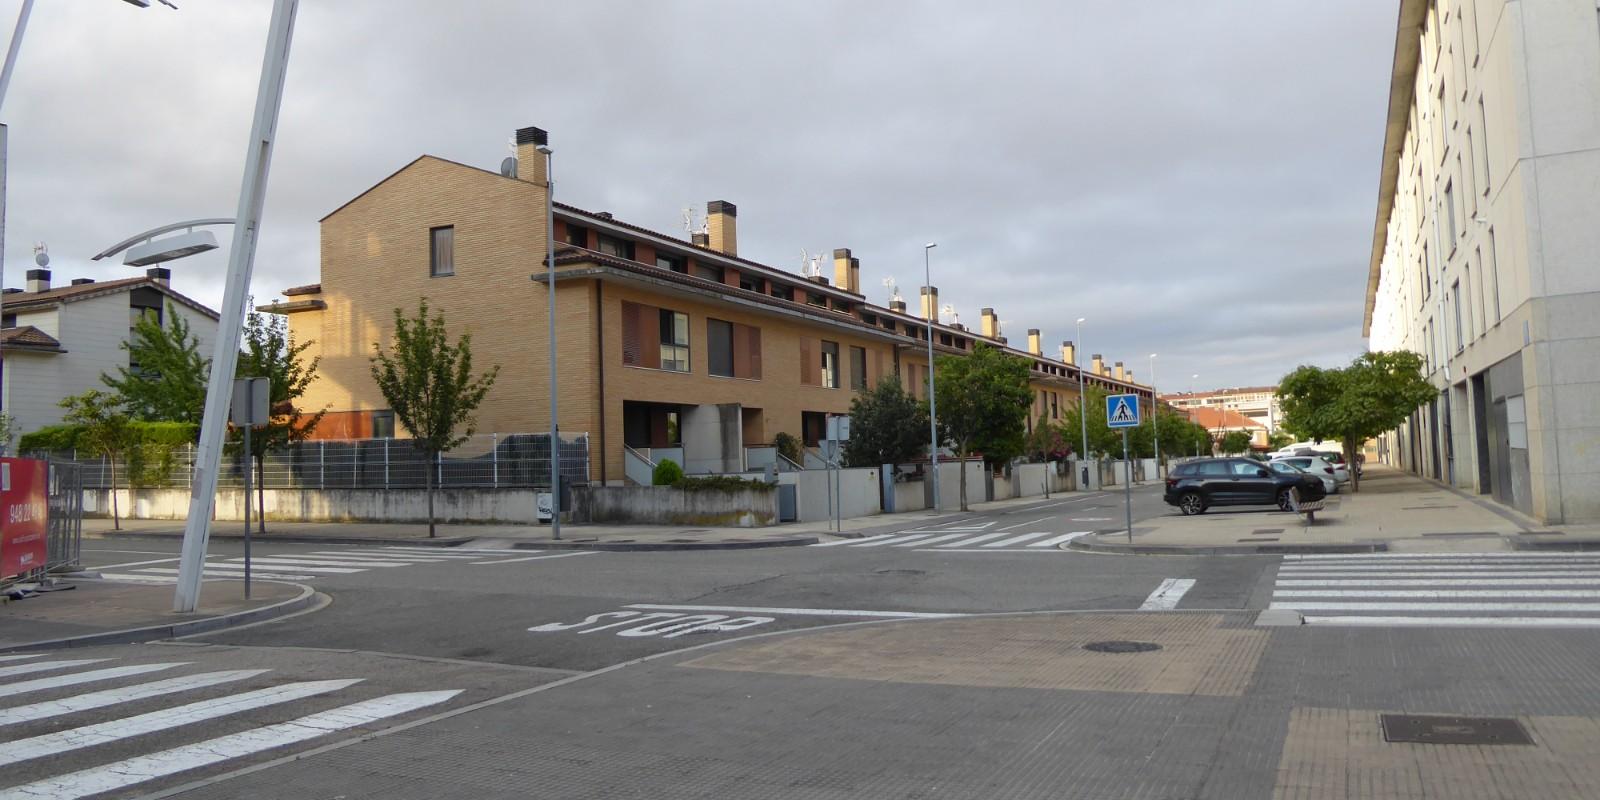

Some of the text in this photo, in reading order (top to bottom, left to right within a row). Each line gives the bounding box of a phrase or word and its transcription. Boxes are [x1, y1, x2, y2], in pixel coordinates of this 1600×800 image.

[10, 503, 23, 524] 948
[23, 503, 31, 522] 22
[528, 611, 775, 638] STOP
